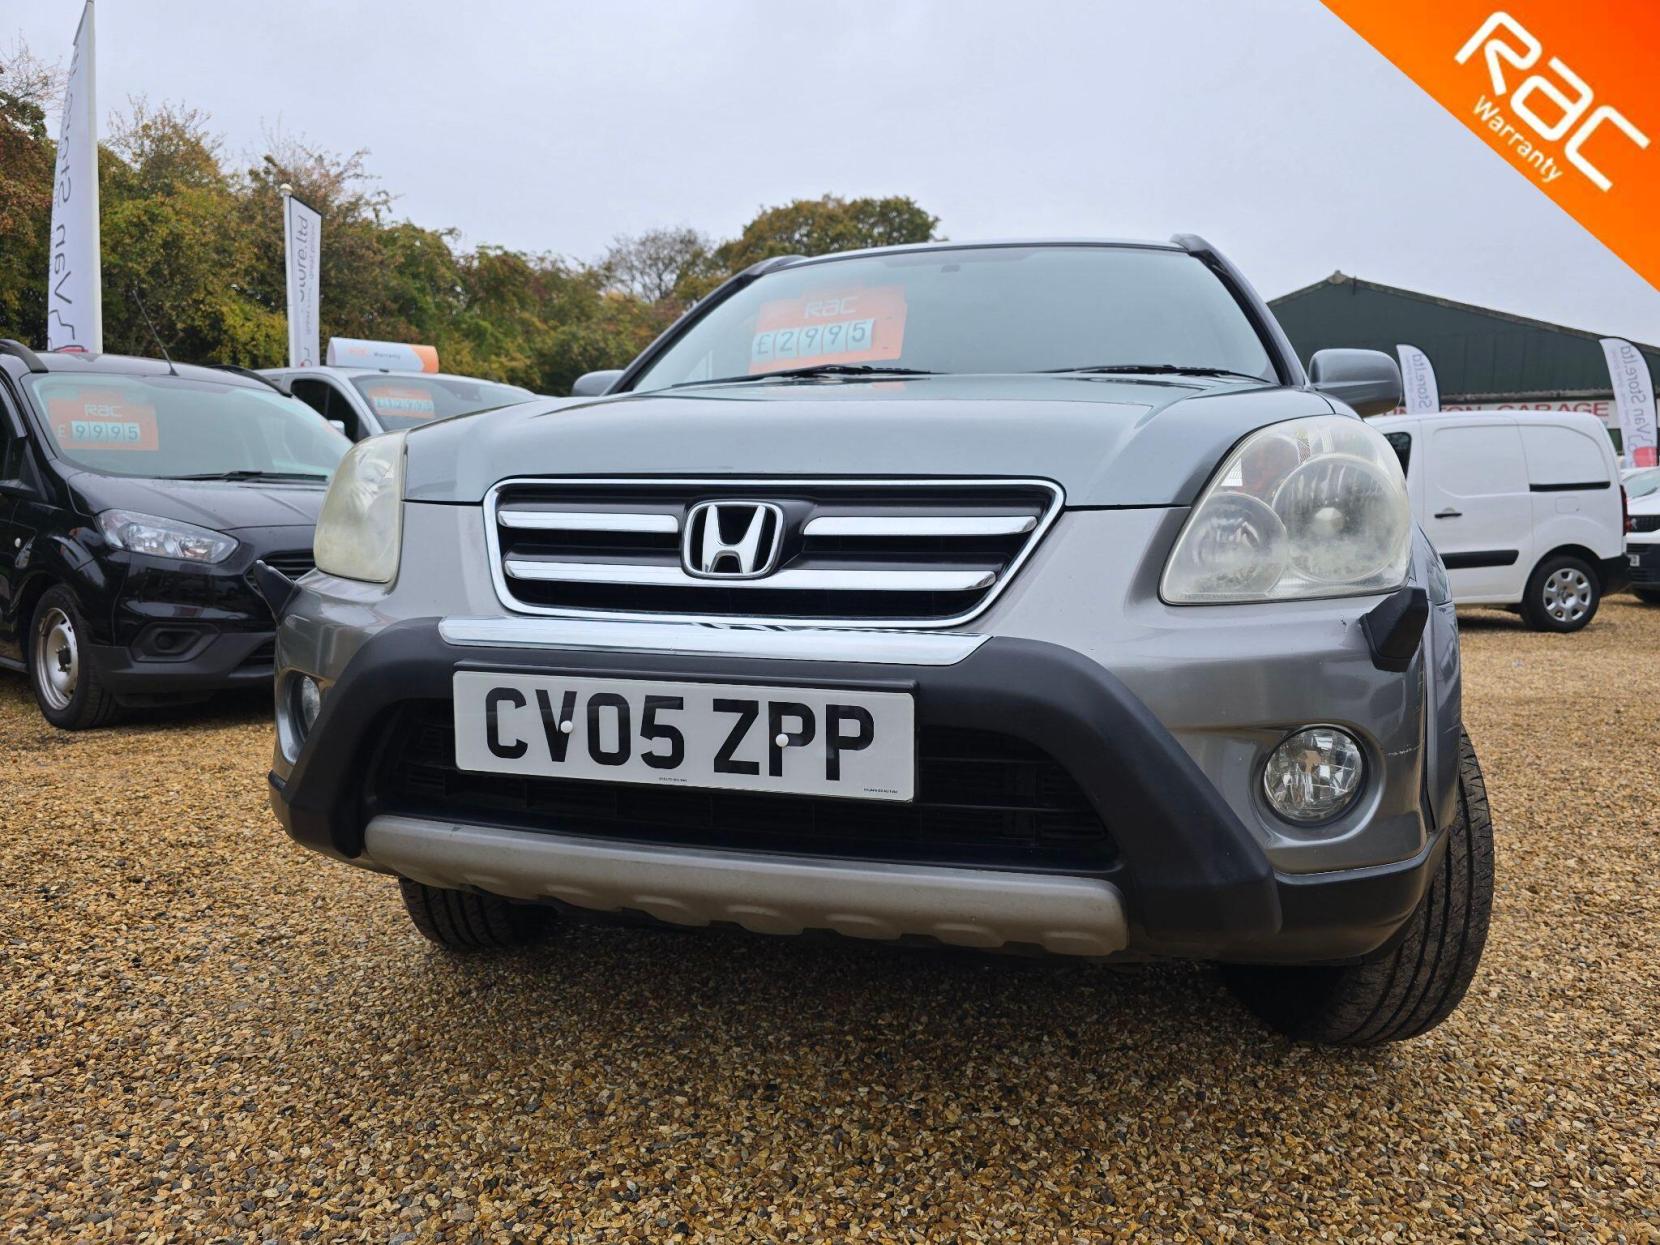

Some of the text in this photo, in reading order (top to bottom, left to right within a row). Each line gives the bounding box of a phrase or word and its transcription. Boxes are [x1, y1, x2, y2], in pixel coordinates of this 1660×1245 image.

[757, 321, 866, 355] £2995
[485, 686, 875, 781] CV05 ZPP
